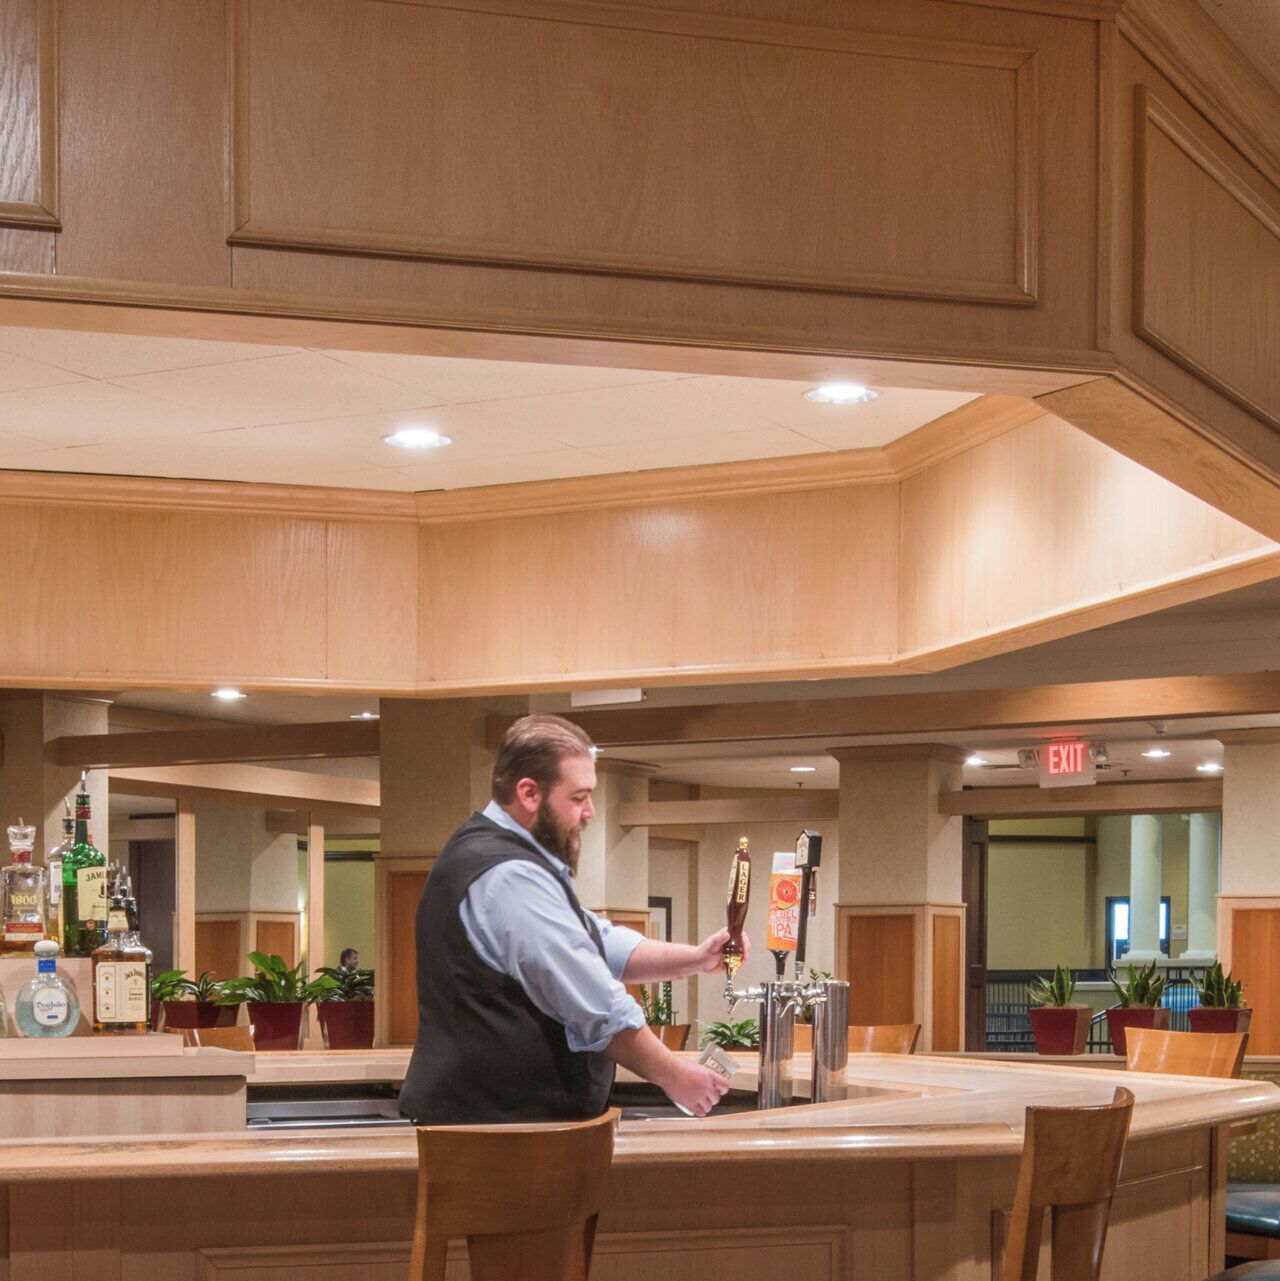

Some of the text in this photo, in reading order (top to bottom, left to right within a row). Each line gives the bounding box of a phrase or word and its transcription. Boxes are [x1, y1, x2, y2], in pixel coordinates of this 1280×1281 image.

[1048, 743, 1084, 774] EXIT
[738, 863, 748, 901] LAGER
[10, 894, 36, 905] 1800
